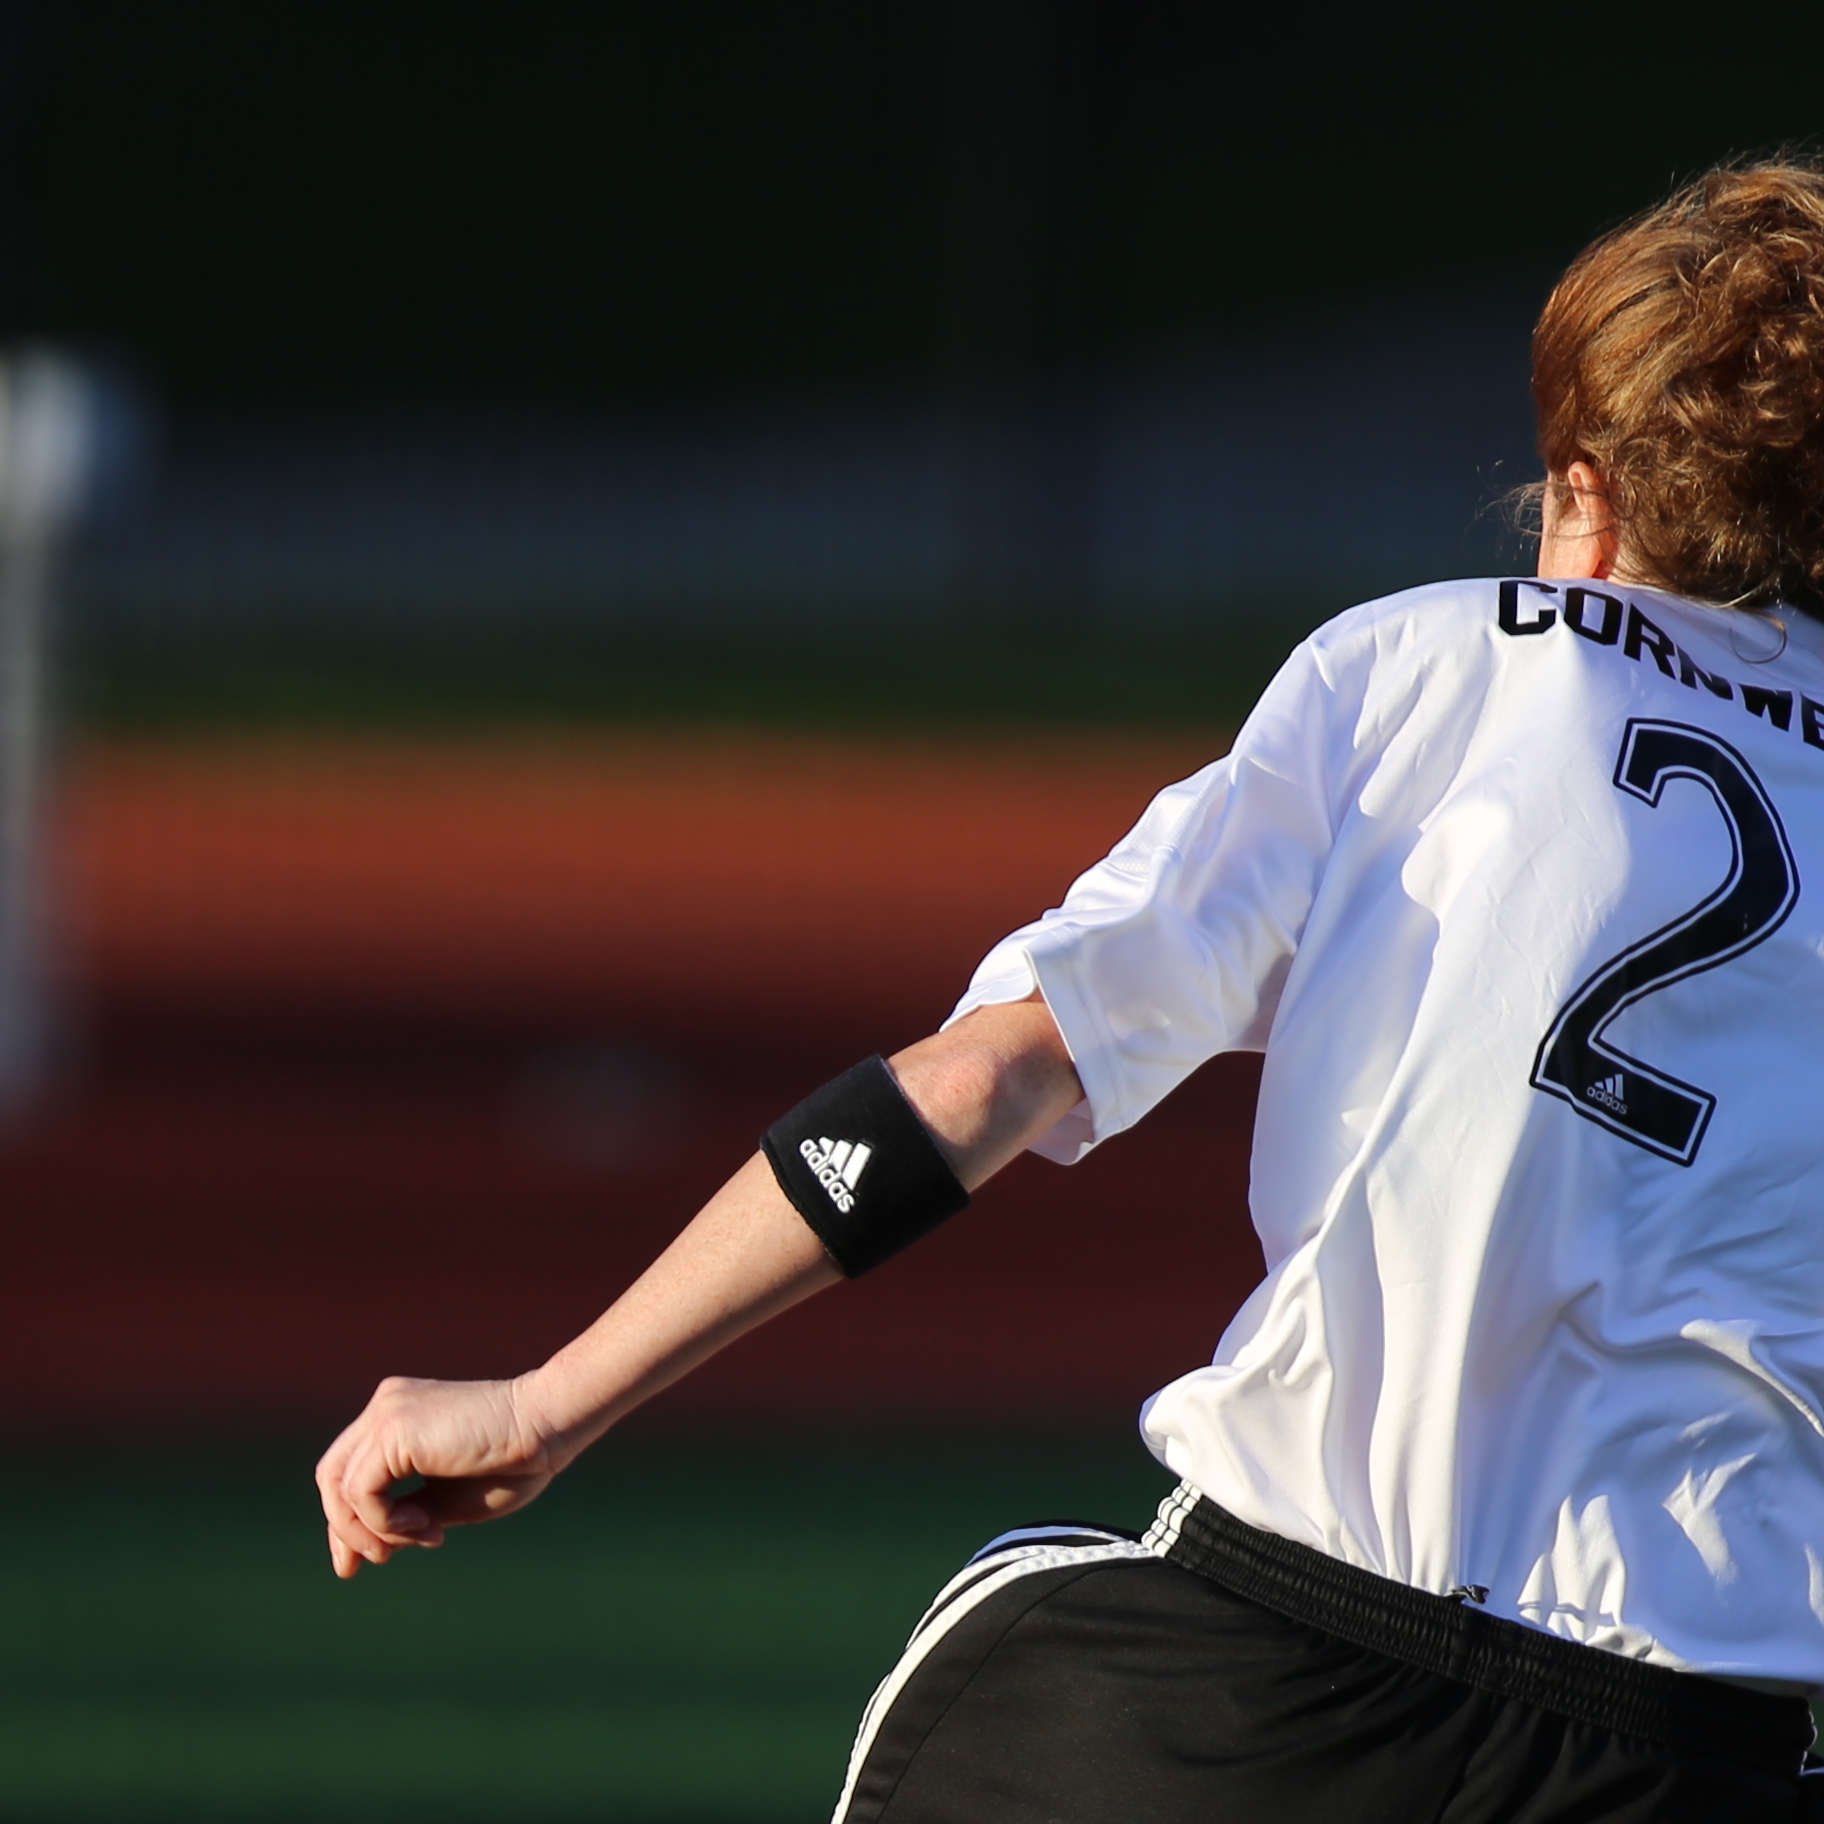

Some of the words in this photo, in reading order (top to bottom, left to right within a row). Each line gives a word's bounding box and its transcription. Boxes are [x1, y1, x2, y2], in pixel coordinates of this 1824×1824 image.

[1529, 717, 1801, 1167] 2
[1587, 1086, 1628, 1115] adidas
[799, 1138, 855, 1213] adidas
